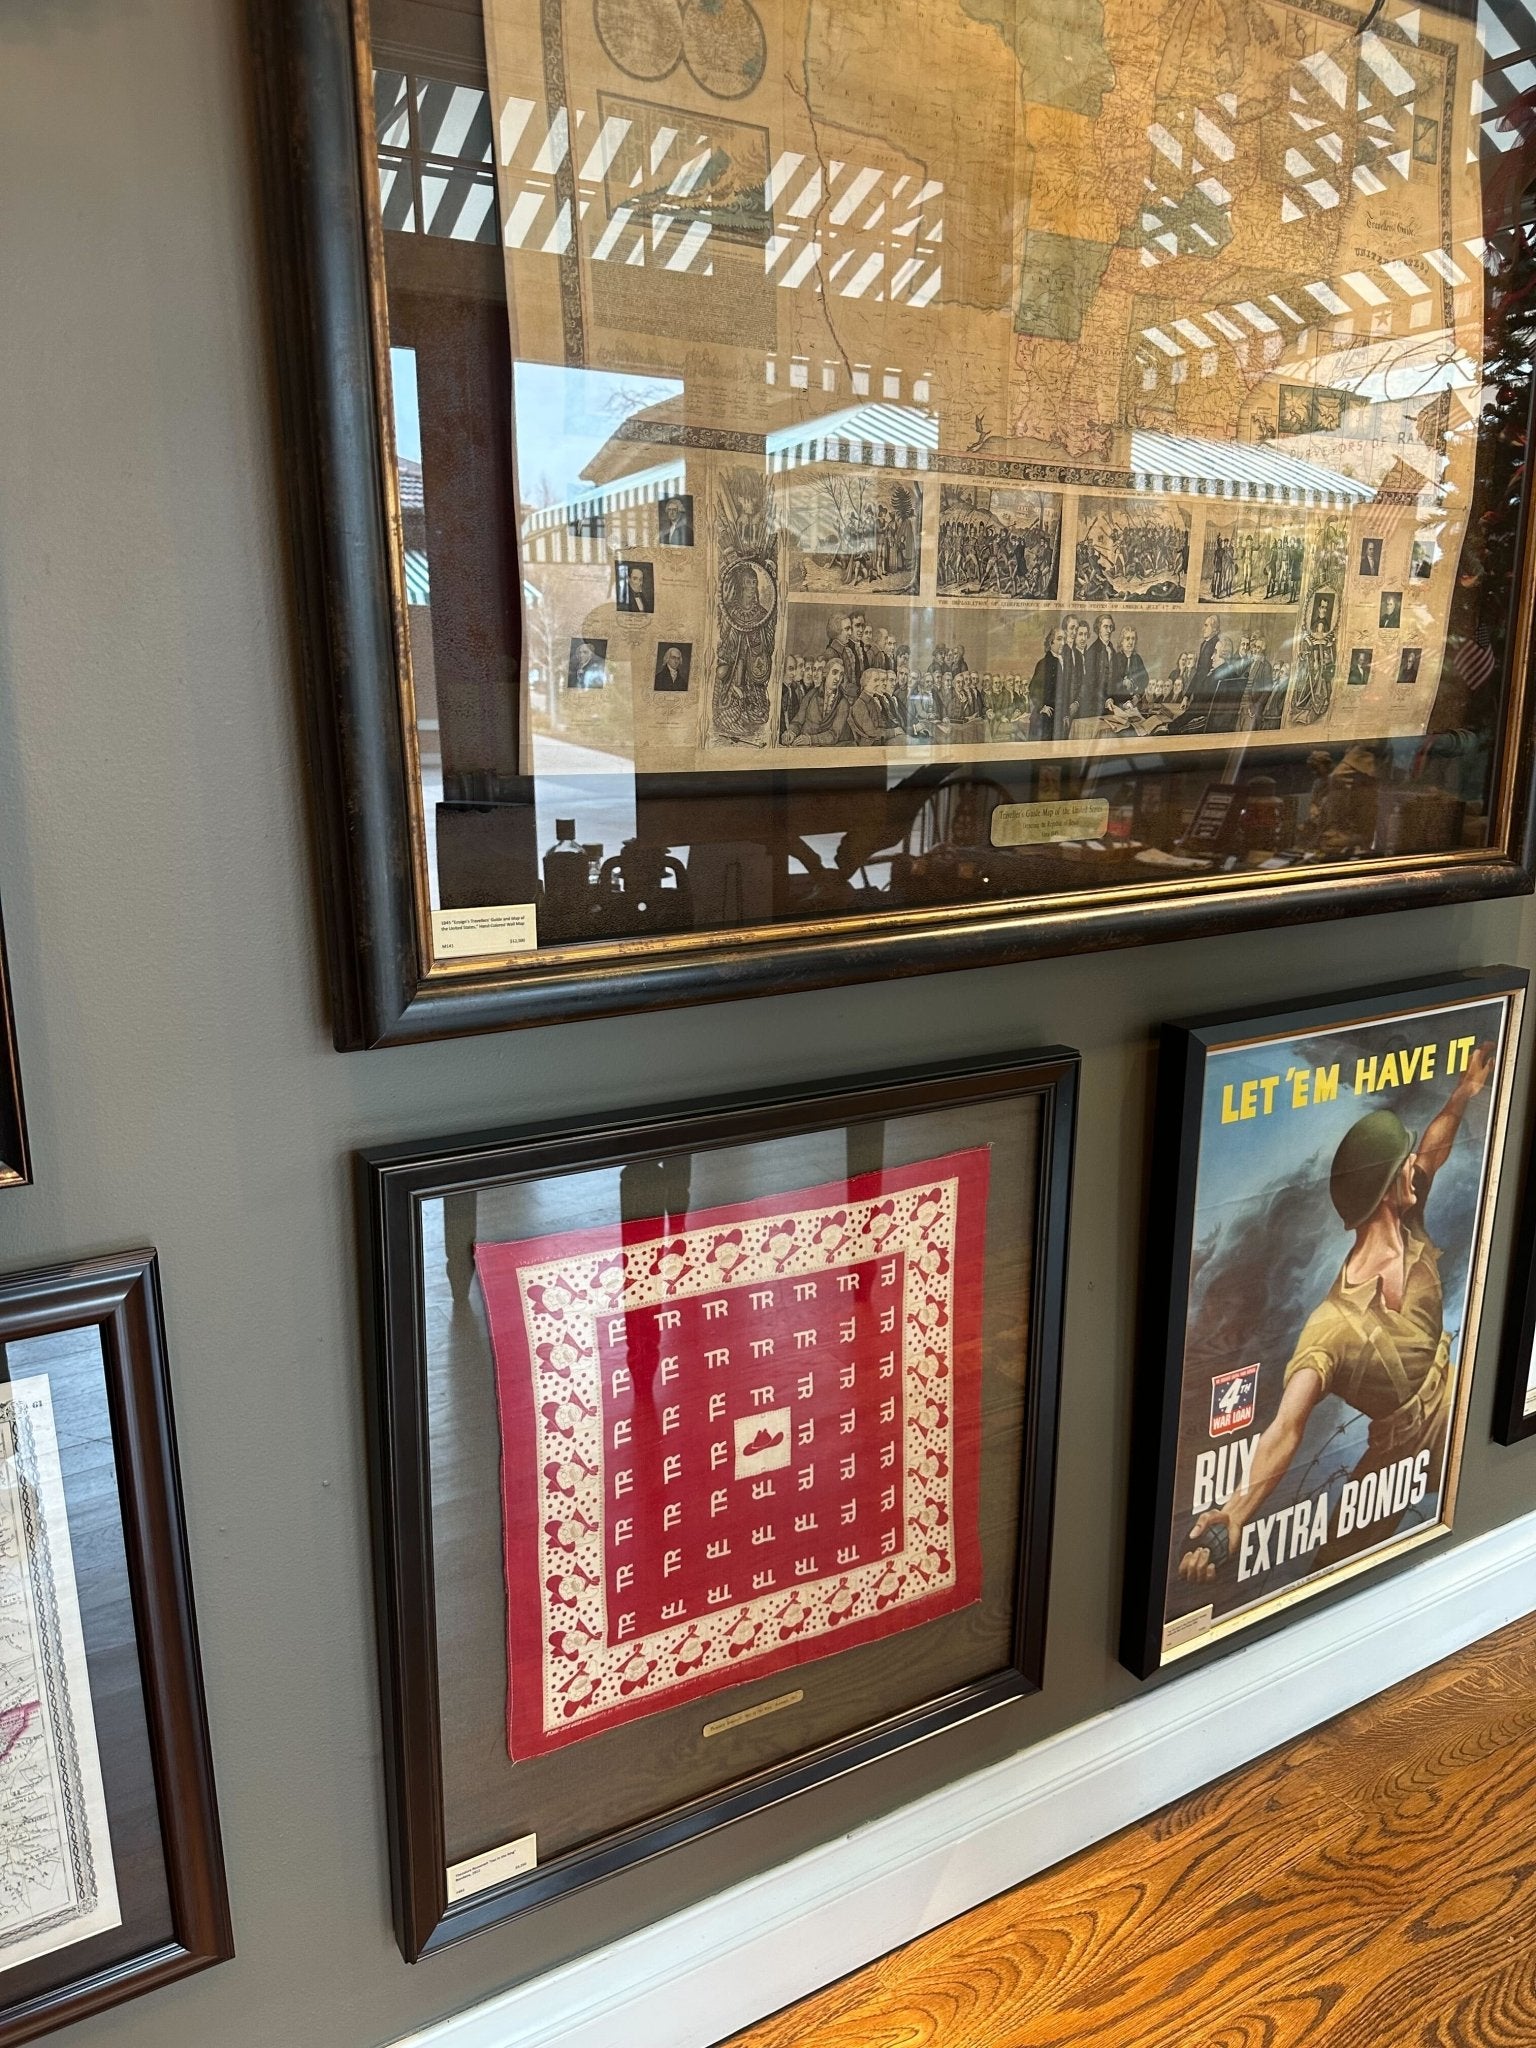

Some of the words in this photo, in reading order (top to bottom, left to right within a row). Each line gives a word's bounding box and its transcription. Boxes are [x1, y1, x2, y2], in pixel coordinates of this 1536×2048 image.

[1025, 809, 1041, 818] Guide
[1042, 807, 1054, 818] Map
[1055, 807, 1061, 815] of
[1221, 1076, 1280, 1125] LET
[1285, 1064, 1340, 1109] 'EM
[1354, 1044, 1437, 1096] HAVE
[1446, 1036, 1476, 1075] IT
[836, 1273, 859, 1292] TR
[880, 1260, 895, 1286] TR
[748, 1290, 773, 1310] TR
[793, 1281, 816, 1301] TR
[653, 1309, 681, 1331] TR
[701, 1299, 728, 1320] TR
[879, 1305, 894, 1333] TR
[608, 1317, 627, 1346] TR
[793, 1328, 816, 1348] TR
[839, 1316, 855, 1343] TR
[703, 1347, 729, 1368] TR
[749, 1338, 774, 1358] TR
[660, 1355, 679, 1386] TR
[839, 1362, 855, 1389] TR
[879, 1350, 893, 1379] TR
[611, 1367, 630, 1398] TR
[749, 1385, 774, 1406] TR
[797, 1371, 813, 1399] TR
[662, 1404, 679, 1435] TR
[708, 1392, 725, 1422] TR
[839, 1407, 855, 1434] TR
[879, 1396, 894, 1423] TR
[1213, 1413, 1231, 1430] WAR
[1232, 1406, 1252, 1423] LOAN
[613, 1418, 631, 1449] TR
[798, 1417, 814, 1445] TR
[710, 1440, 727, 1470] TR
[839, 1452, 855, 1480] TR
[879, 1440, 894, 1469] TR
[663, 1453, 681, 1484] TR
[797, 1463, 813, 1491] TR
[1192, 1433, 1261, 1515] BUY
[614, 1468, 633, 1499] TR
[751, 1479, 776, 1499] TR
[710, 1487, 727, 1517] TR
[840, 1497, 856, 1525] TR
[880, 1484, 894, 1512] TR
[663, 1501, 681, 1531] TR
[794, 1512, 818, 1532] TR
[1237, 1492, 1328, 1582] EXTRA
[1337, 1449, 1430, 1538] BONDS
[614, 1517, 633, 1546] TR
[751, 1524, 775, 1545] TR
[880, 1527, 895, 1554] TR
[705, 1538, 731, 1559] TR
[836, 1544, 859, 1564] TR
[663, 1548, 681, 1578] TR
[794, 1556, 818, 1575] TR
[616, 1563, 633, 1593] TR
[752, 1568, 776, 1589] TR
[706, 1583, 732, 1604] TR
[660, 1598, 686, 1619] TR
[617, 1611, 635, 1637] TR
